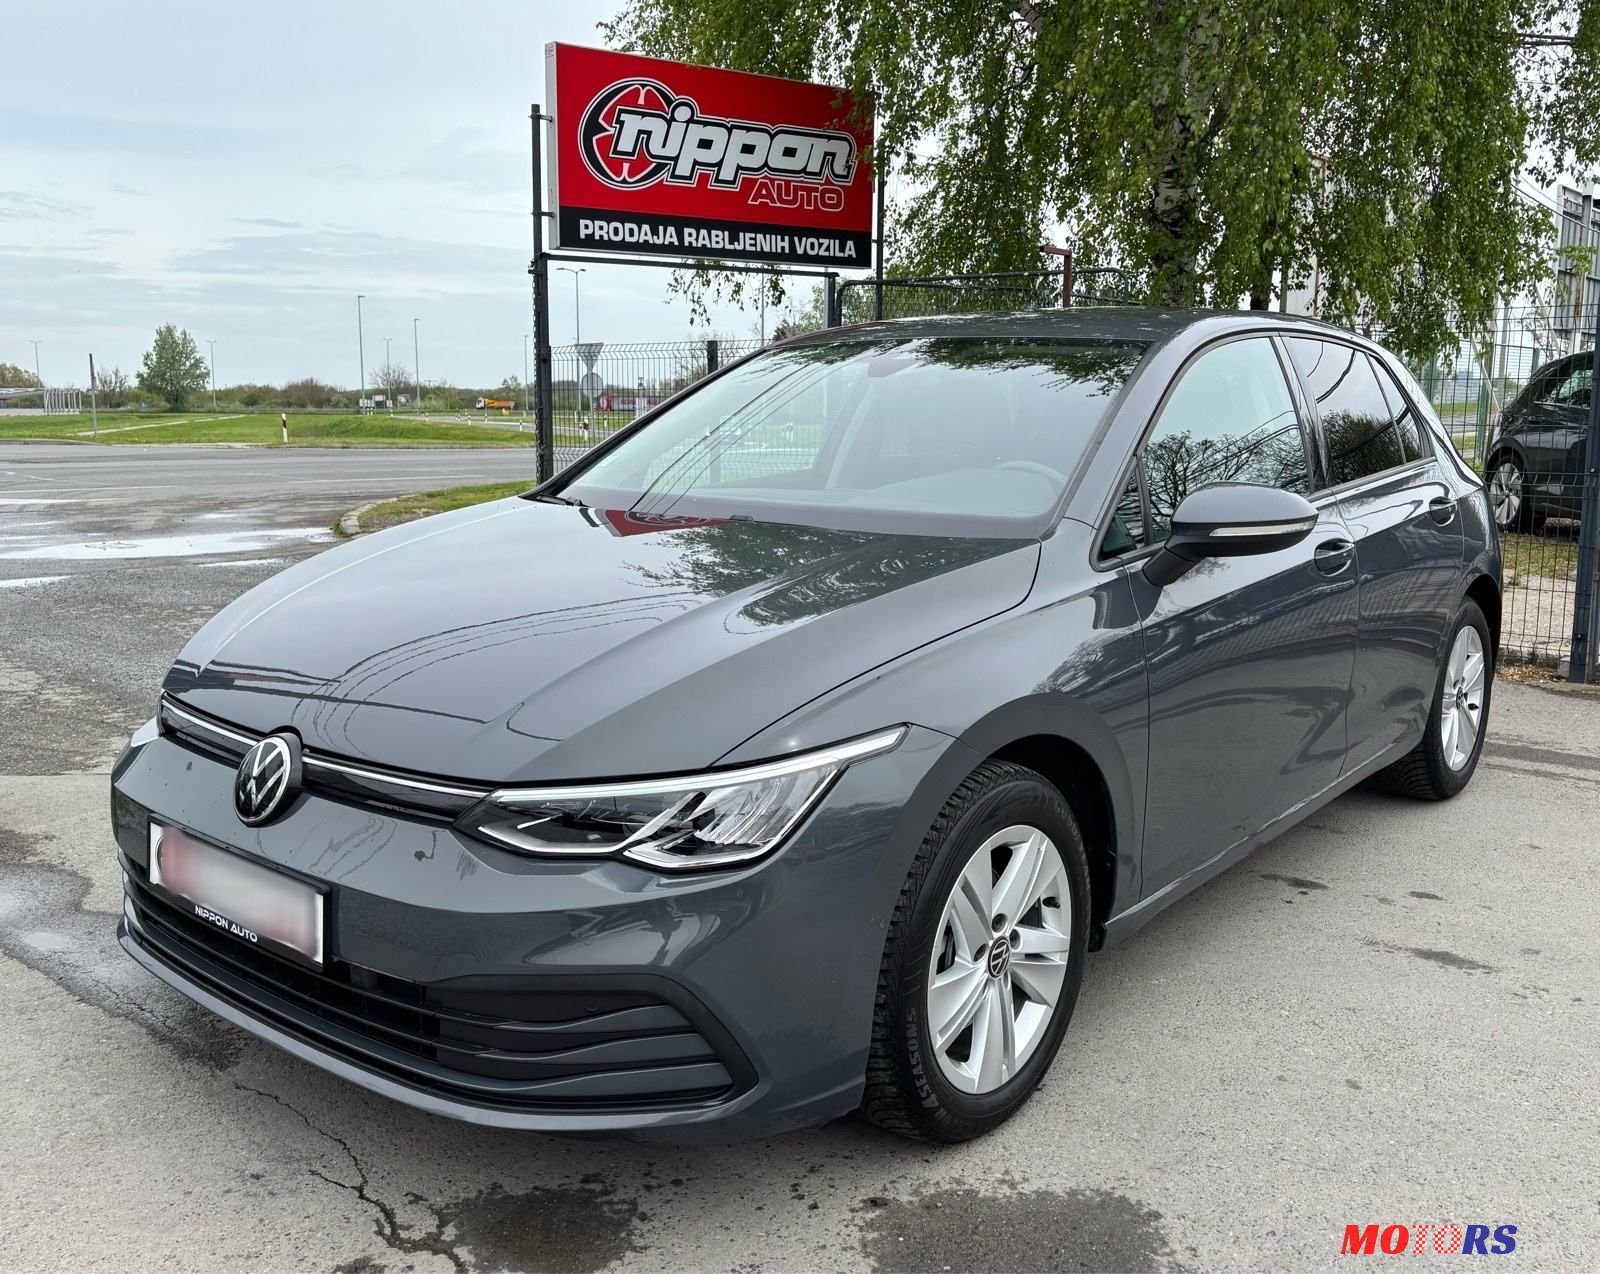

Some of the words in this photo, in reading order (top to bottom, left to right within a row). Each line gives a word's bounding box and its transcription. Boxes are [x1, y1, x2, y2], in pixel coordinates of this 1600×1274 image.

[614, 103, 855, 187] nippon
[748, 179, 844, 212] AUTO
[579, 219, 679, 246] PRODAJA
[683, 228, 790, 255] RABLJENIH
[793, 236, 857, 259] VOZILA
[194, 905, 229, 930] NIPPON
[230, 923, 258, 943] AUTO
